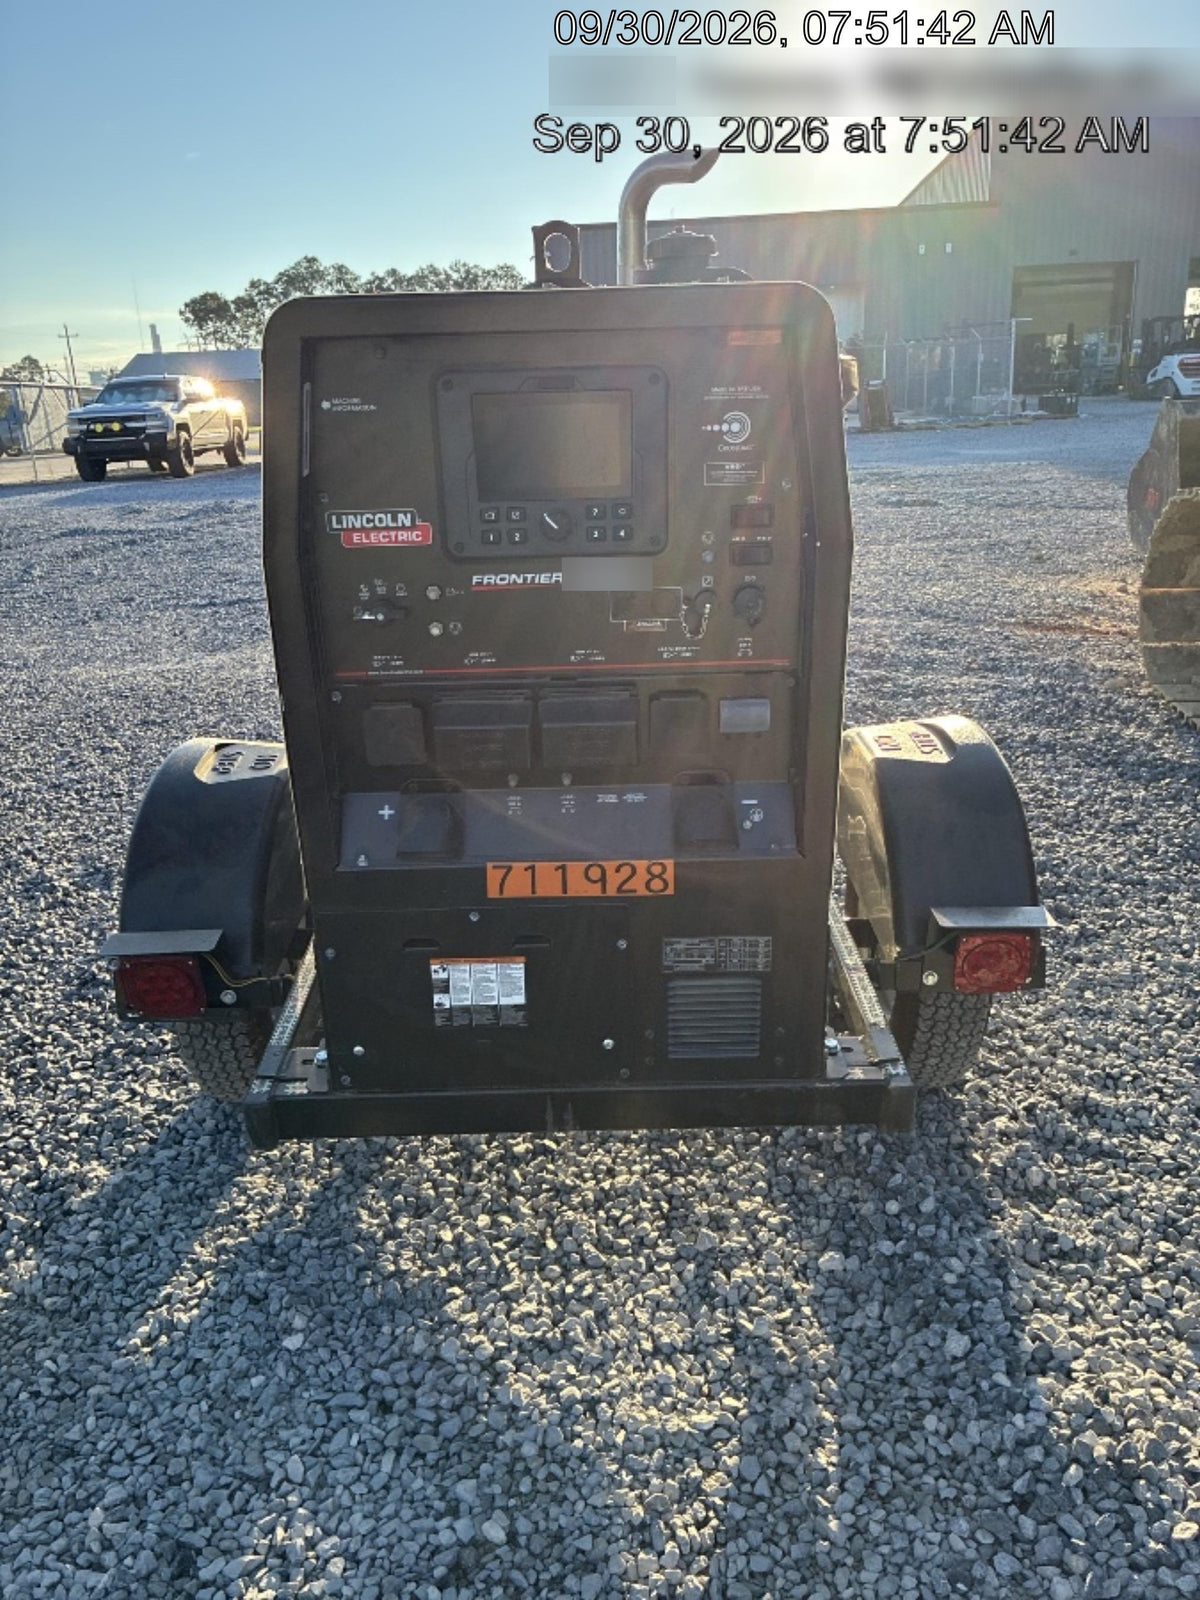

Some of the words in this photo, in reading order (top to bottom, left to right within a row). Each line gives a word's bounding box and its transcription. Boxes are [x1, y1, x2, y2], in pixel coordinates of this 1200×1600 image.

[331, 512, 412, 529] LINCOLN
[352, 531, 422, 543] ELECTRIC
[471, 571, 562, 586] FRONTIER
[491, 861, 670, 896] 711928
